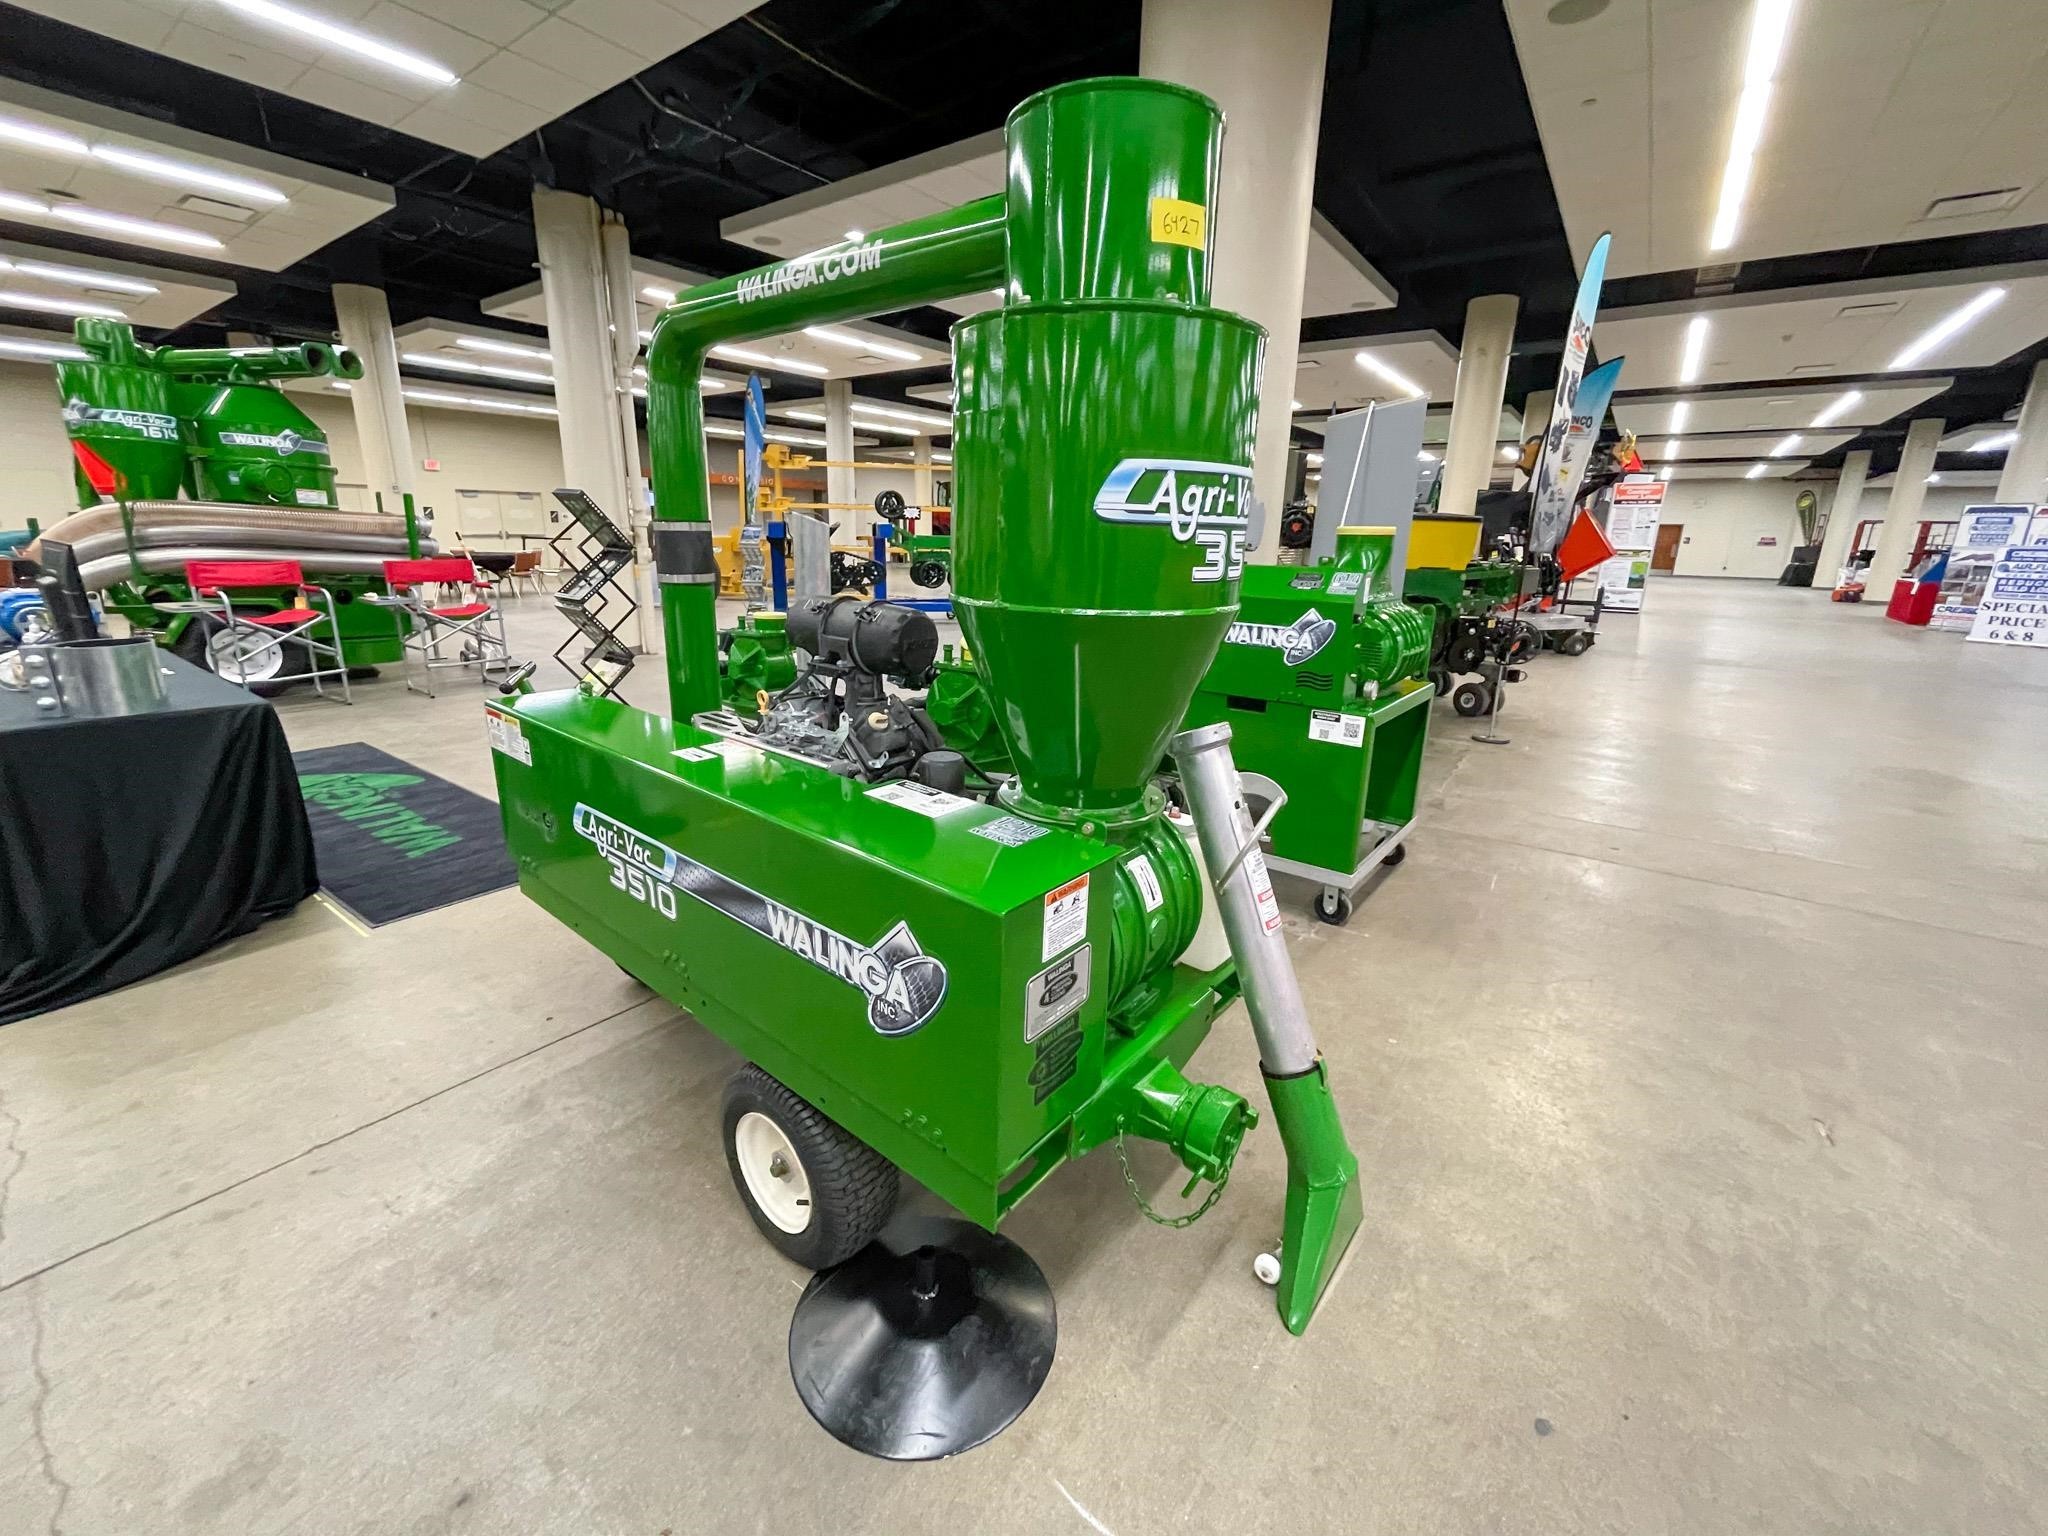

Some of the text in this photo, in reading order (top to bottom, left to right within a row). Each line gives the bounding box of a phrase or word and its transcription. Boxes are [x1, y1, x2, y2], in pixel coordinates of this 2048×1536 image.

[1162, 211, 1200, 236] 6427
[736, 239, 884, 304] WALINGA.COM
[115, 411, 171, 428] Agri-Vac
[234, 433, 293, 450] WALINGA
[1988, 615, 2047, 628] PRICE
[1989, 629, 2034, 642] 6 & 8
[588, 813, 654, 864] Agri-Vac
[609, 854, 677, 920] 3510
[766, 903, 913, 1016] WALINGA
[877, 999, 900, 1020] INC.
